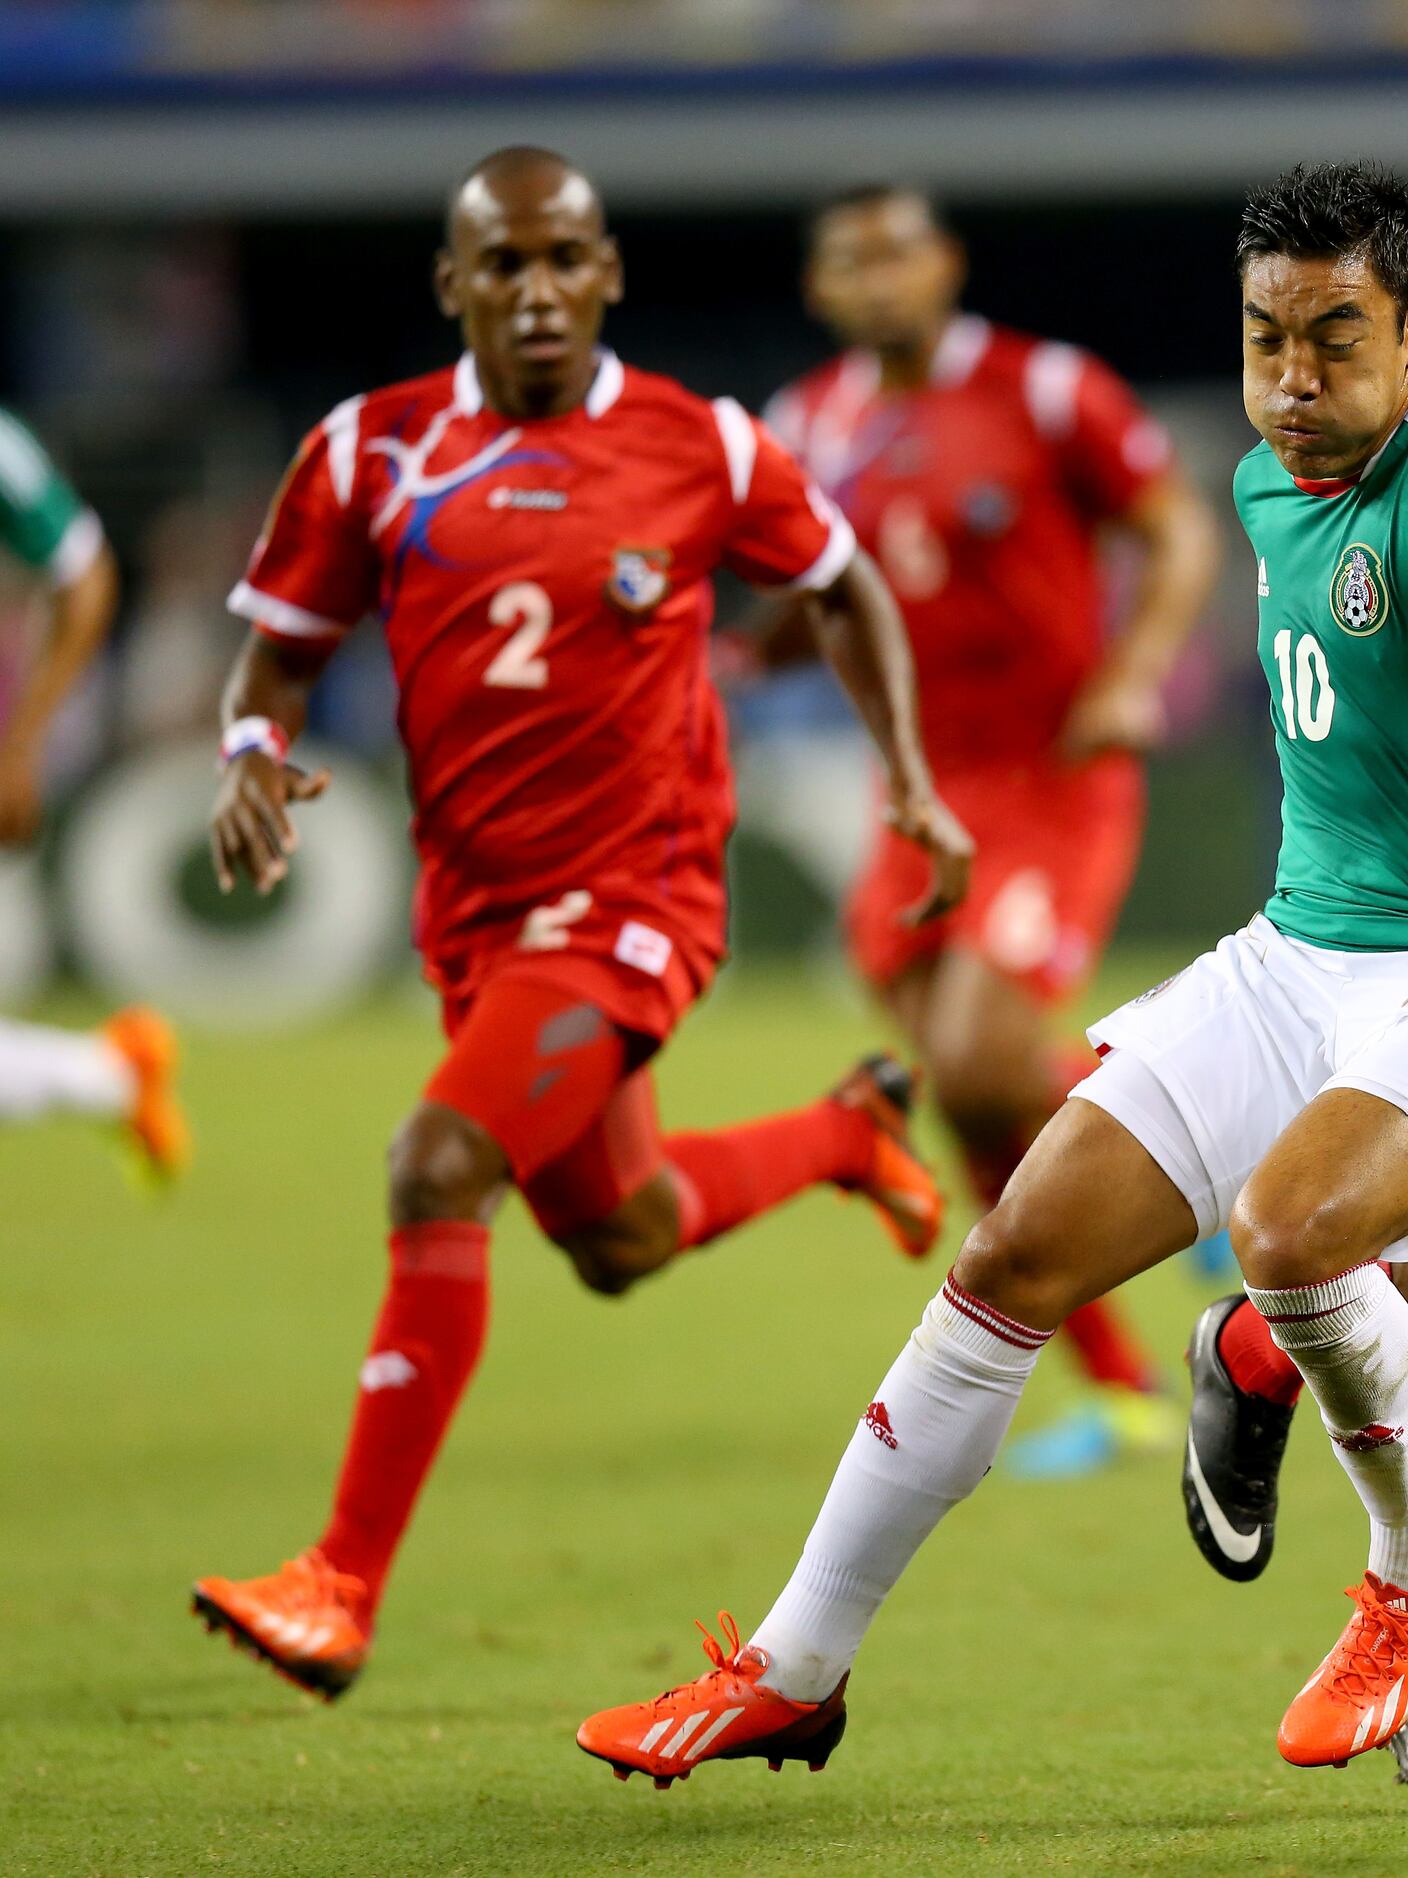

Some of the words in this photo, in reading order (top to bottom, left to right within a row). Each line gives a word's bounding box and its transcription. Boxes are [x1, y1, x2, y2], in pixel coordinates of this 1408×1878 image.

[482, 580, 554, 690] 2
[1274, 629, 1336, 742] 10
[515, 889, 594, 951] 2
